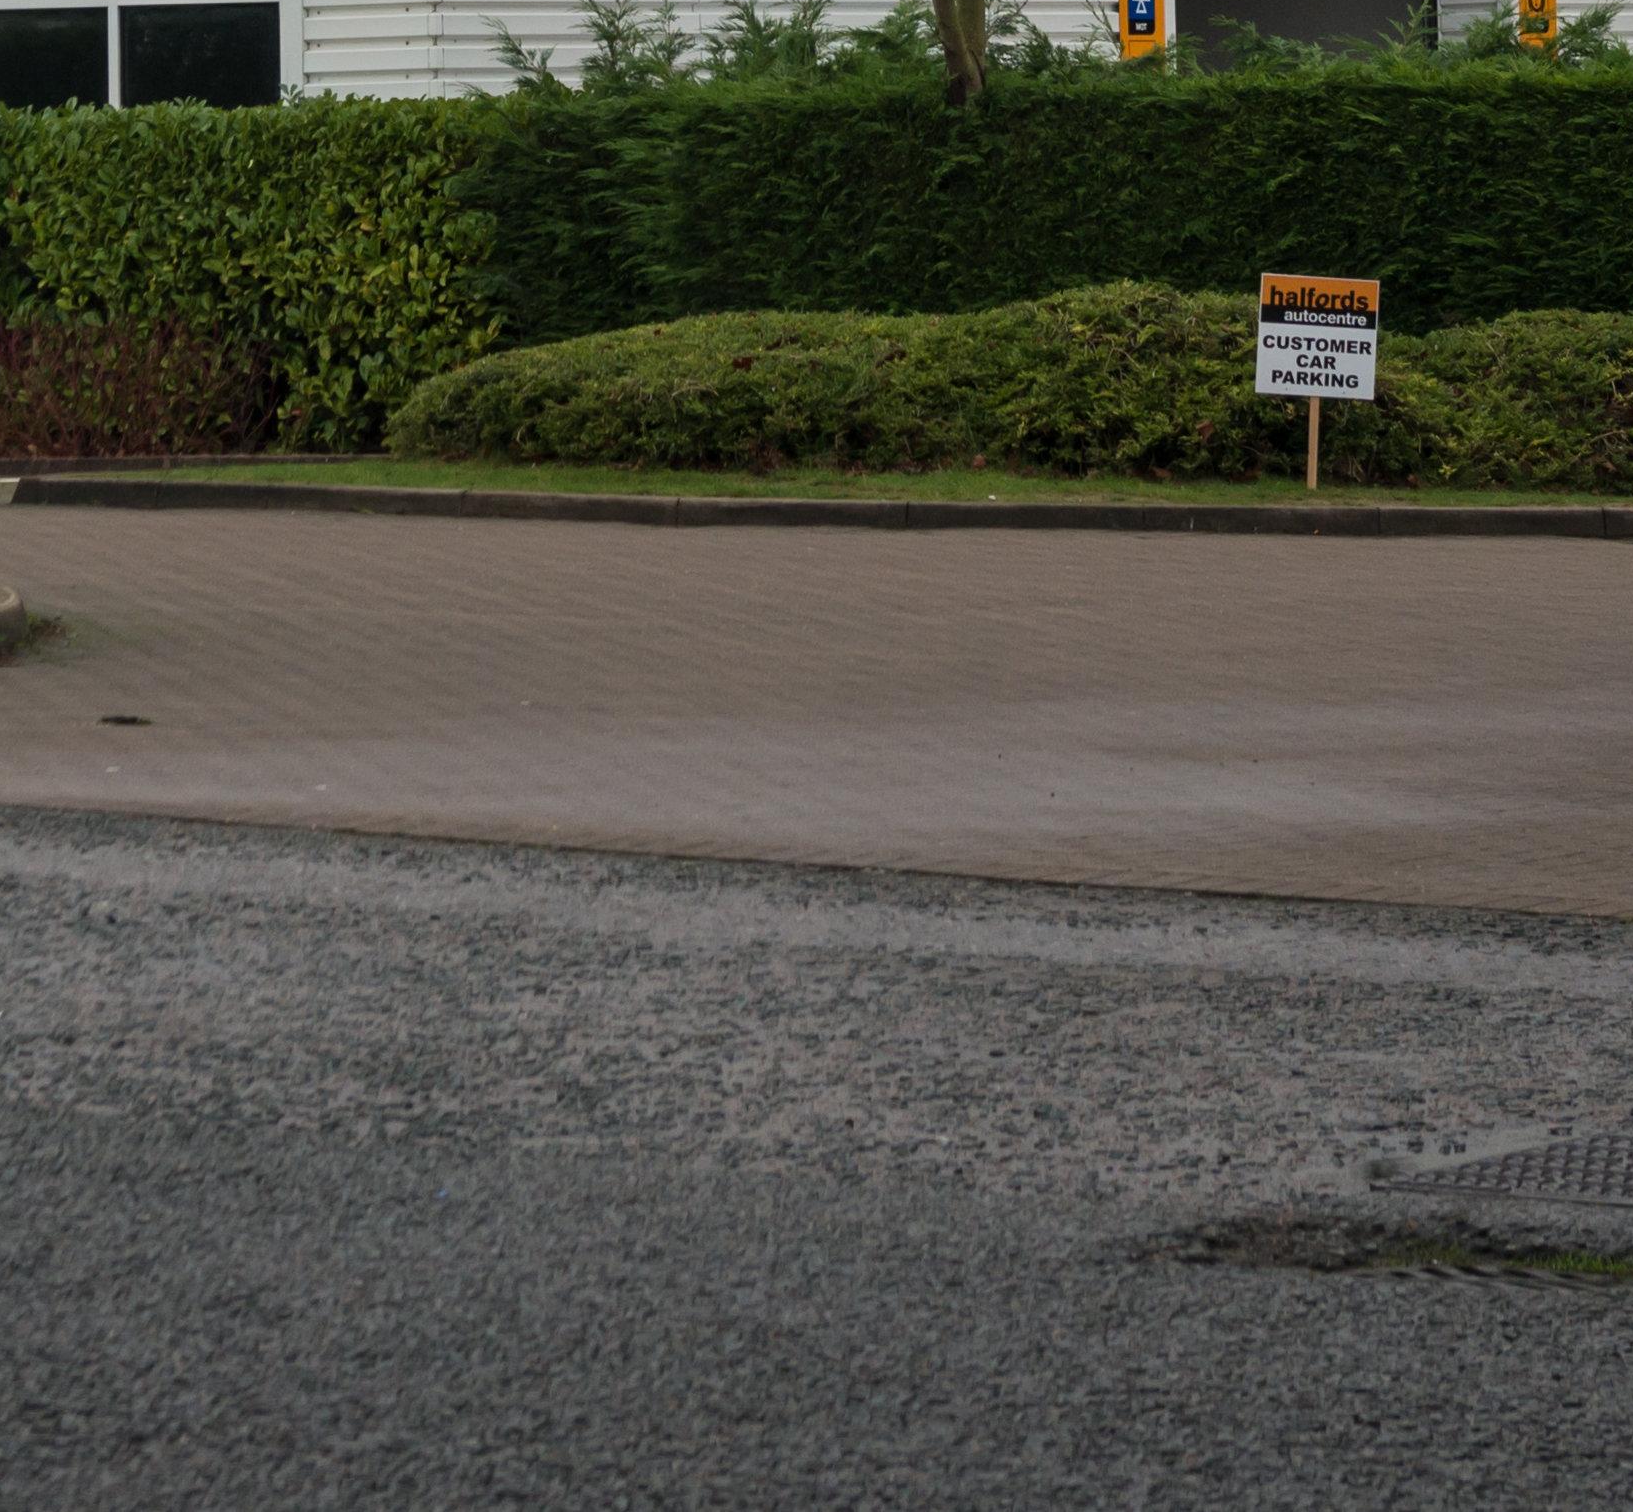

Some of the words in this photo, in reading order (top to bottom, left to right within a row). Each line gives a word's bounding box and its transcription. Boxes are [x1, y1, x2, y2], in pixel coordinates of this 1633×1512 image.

[1269, 284, 1370, 312] halfords
[1283, 309, 1368, 327] autocentre
[1262, 334, 1372, 356] CUSTOMER
[1296, 353, 1337, 371] CAR
[1270, 369, 1359, 389] PARKING
